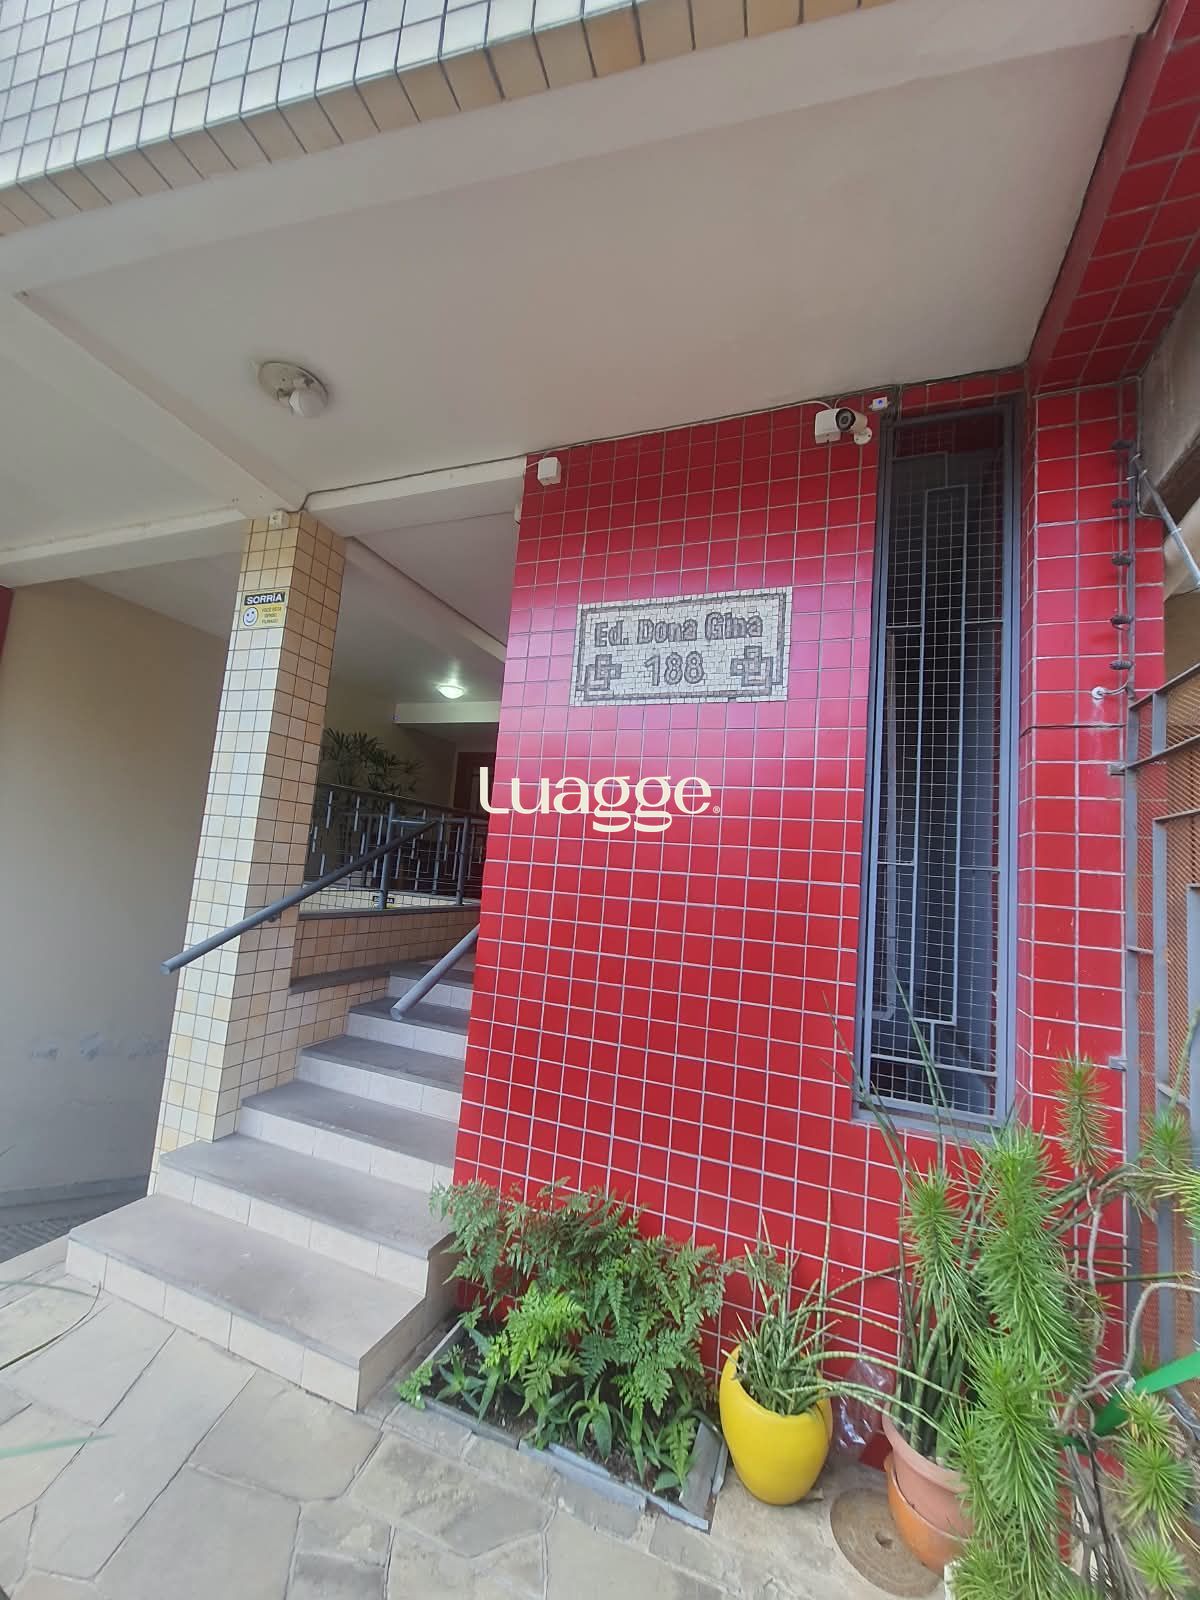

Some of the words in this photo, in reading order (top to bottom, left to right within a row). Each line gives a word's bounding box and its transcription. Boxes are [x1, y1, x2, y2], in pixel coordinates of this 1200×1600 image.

[246, 593, 282, 604] SORRIA
[594, 619, 629, 647] Ed.
[637, 615, 698, 644] Dona
[644, 650, 705, 686] 188
